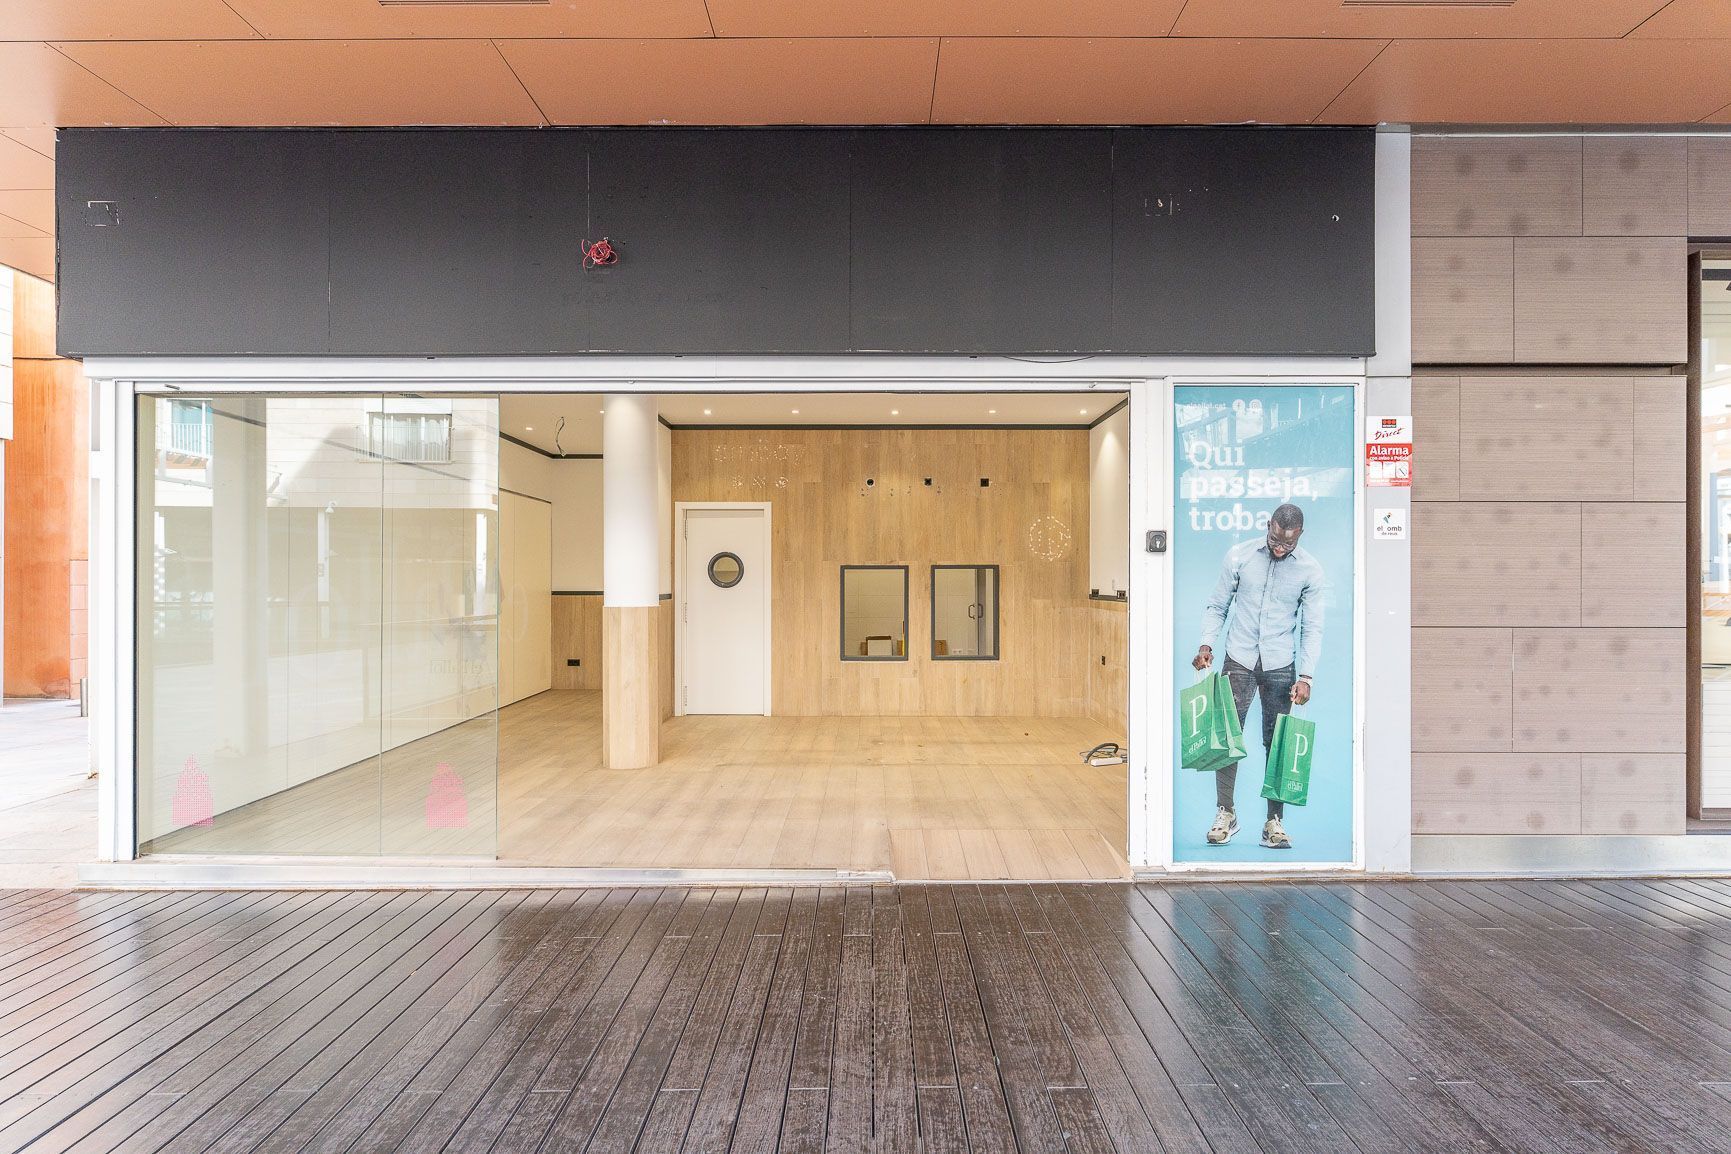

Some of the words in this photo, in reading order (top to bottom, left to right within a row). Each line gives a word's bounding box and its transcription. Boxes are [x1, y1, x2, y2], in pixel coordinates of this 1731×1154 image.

[1188, 439, 1246, 470] Qui
[1369, 445, 1409, 455] Alarma
[1188, 467, 1318, 503] passeja,
[1188, 502, 1272, 531] troba
[1189, 694, 1208, 738] P
[1290, 733, 1308, 773] P
